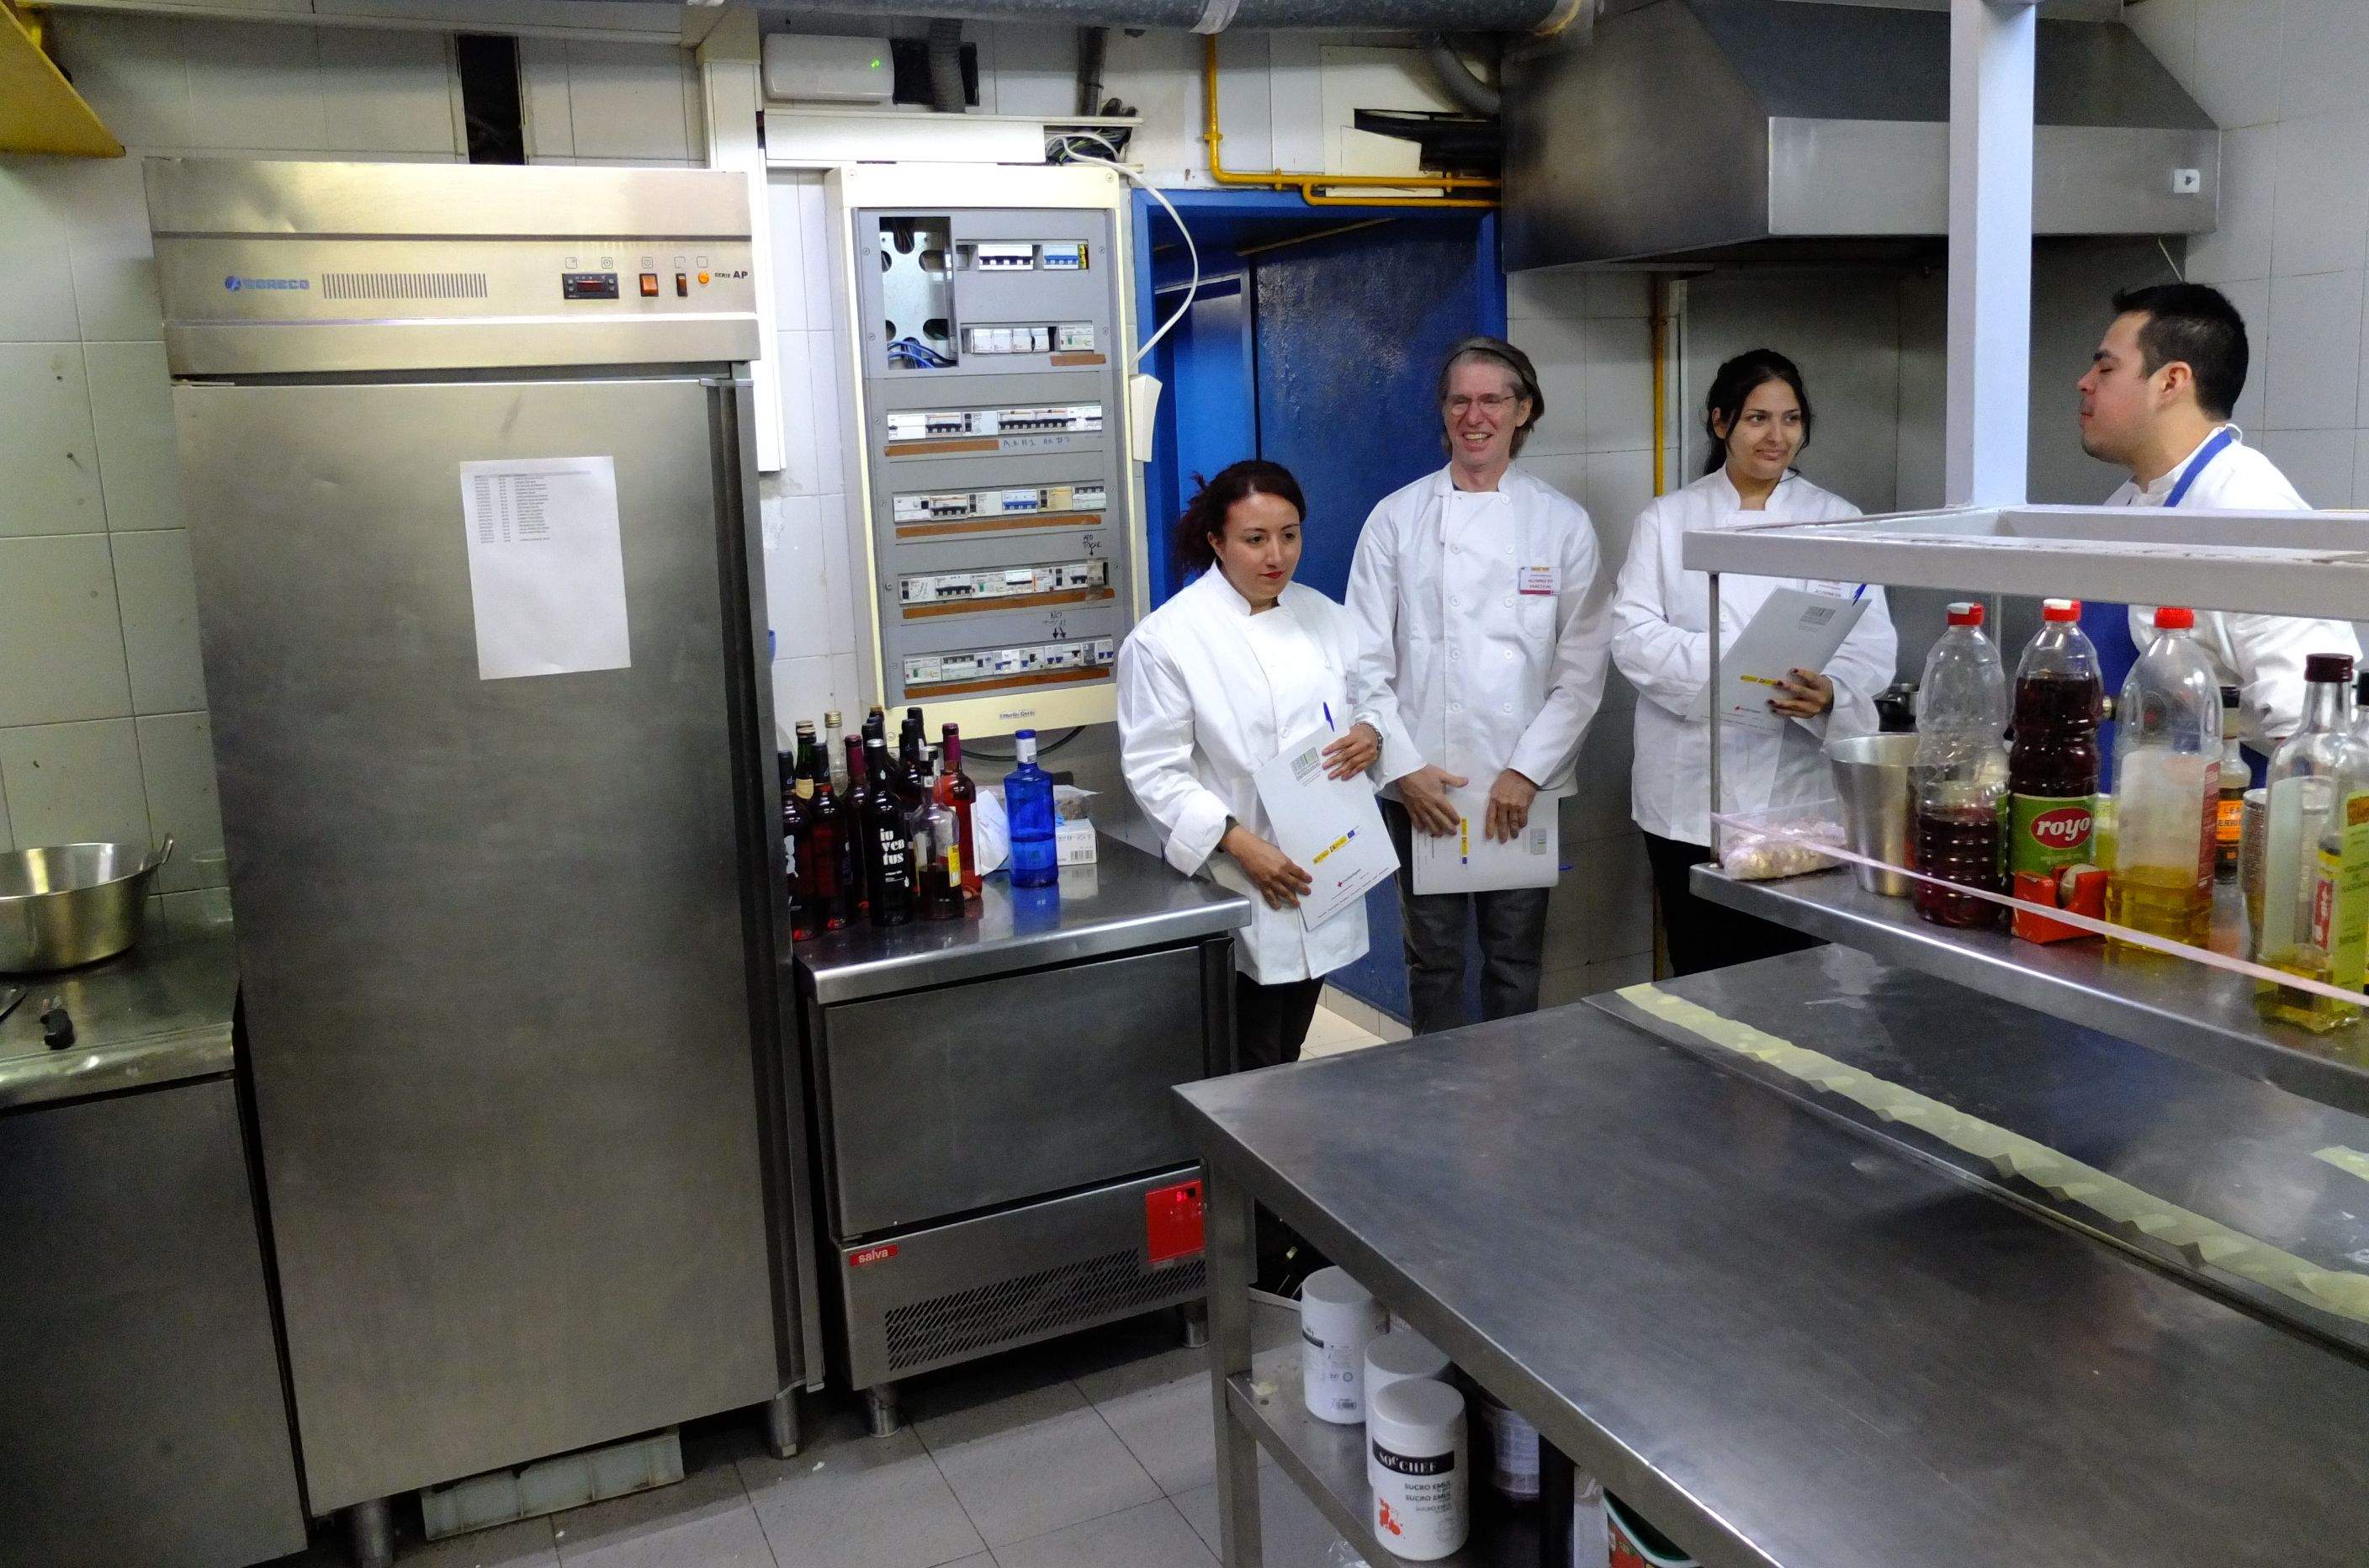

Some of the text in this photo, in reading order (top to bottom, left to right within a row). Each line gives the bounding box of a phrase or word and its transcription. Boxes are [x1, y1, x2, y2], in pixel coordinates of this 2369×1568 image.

[732, 270, 748, 279] AP
[2036, 818, 2091, 841] royo
[883, 852, 904, 866] tus
[858, 1249, 888, 1263] salva
